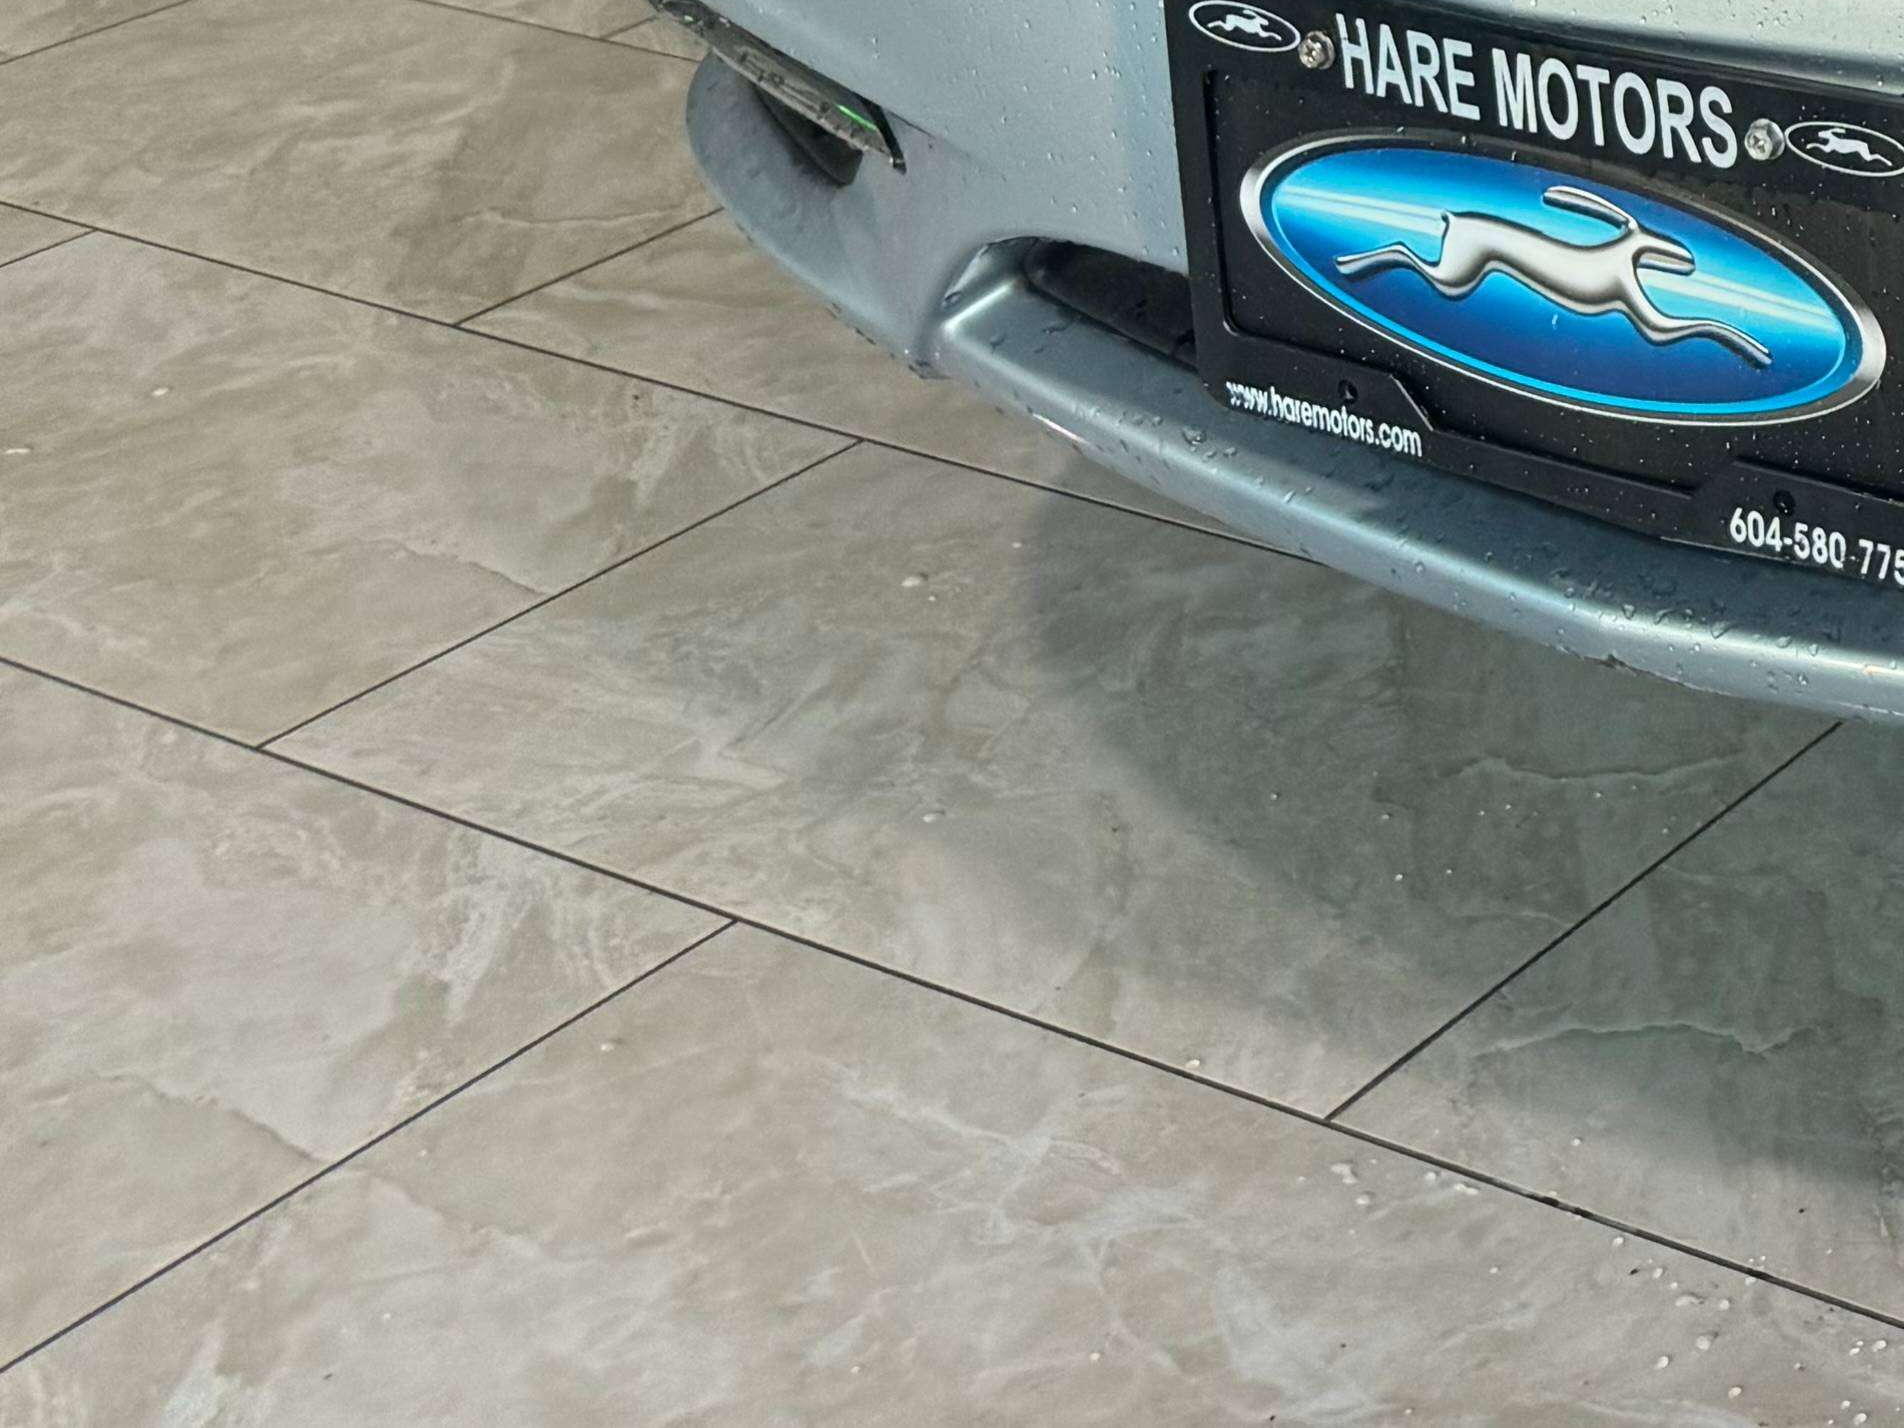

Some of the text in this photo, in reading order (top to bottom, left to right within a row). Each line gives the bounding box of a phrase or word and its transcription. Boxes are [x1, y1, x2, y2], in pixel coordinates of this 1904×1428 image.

[1335, 12, 1739, 169] HARE MOTORS
[1225, 380, 1423, 458] www.haremotors.com
